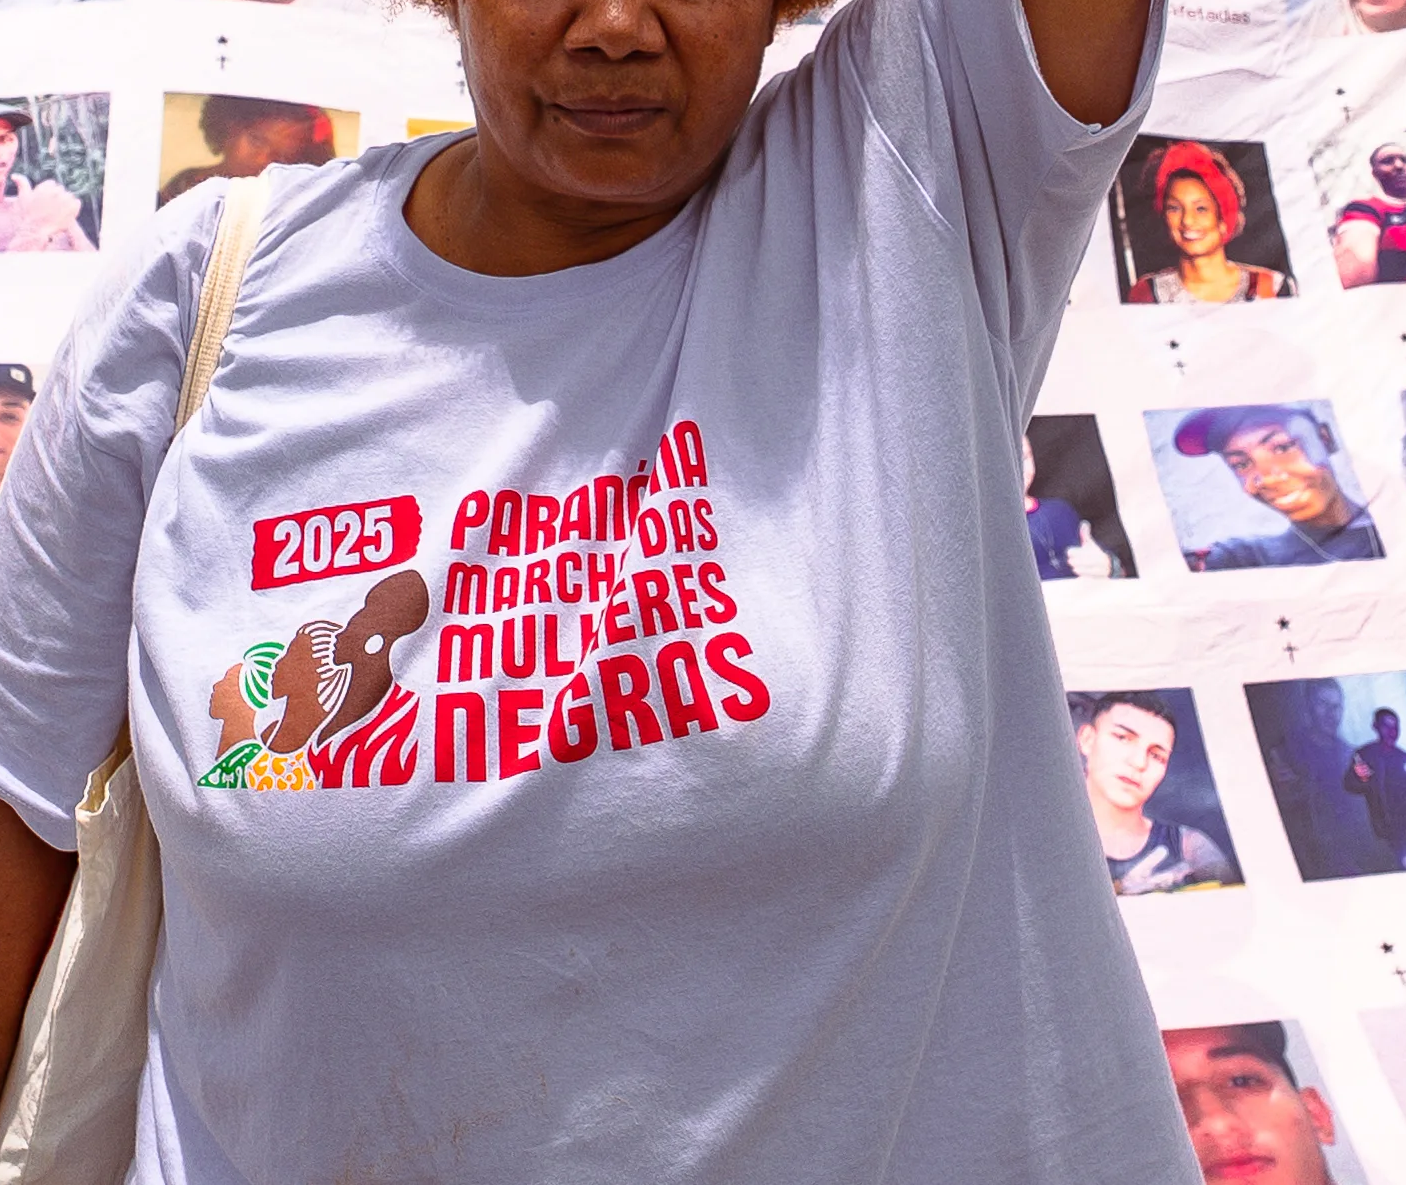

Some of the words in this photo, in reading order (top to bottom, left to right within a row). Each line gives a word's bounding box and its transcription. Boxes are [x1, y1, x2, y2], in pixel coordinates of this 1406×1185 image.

[273, 505, 393, 578] 2025
[443, 542, 630, 615] MARCH
[638, 498, 719, 559] DAS
[437, 561, 738, 683] MULHERES
[434, 632, 772, 783] NEGRAS
